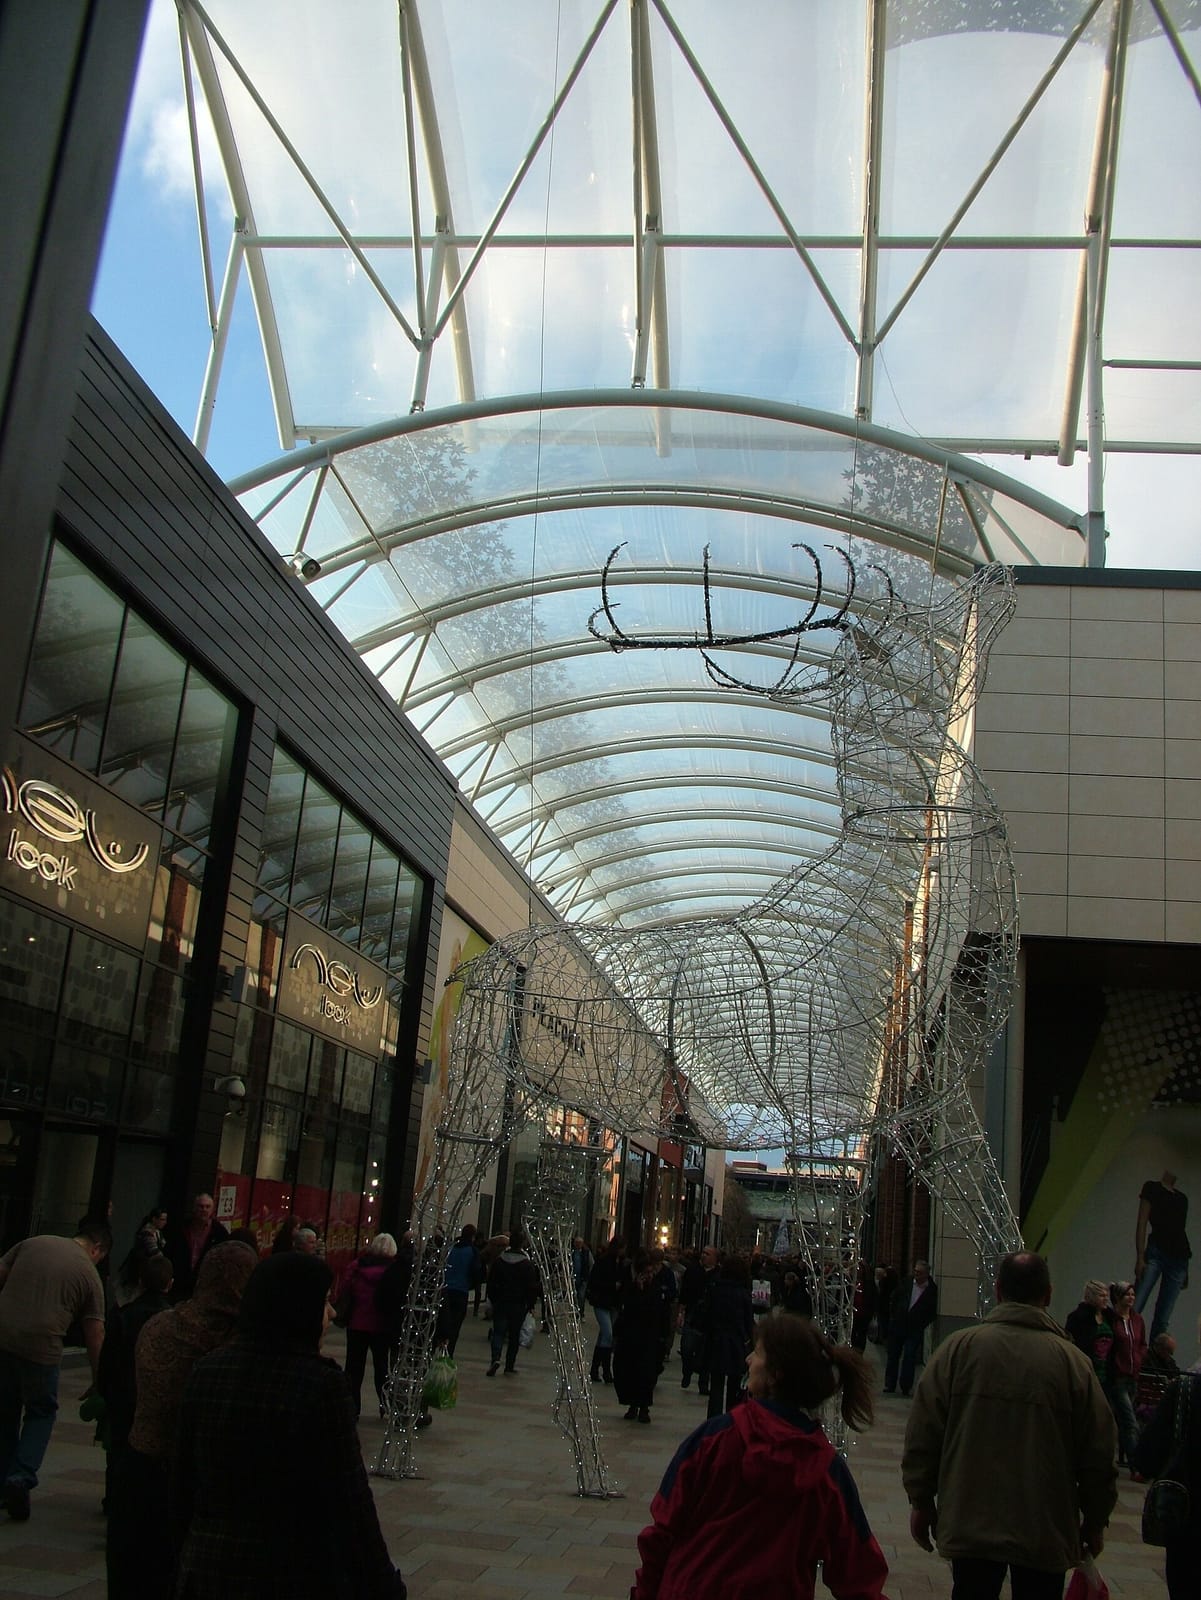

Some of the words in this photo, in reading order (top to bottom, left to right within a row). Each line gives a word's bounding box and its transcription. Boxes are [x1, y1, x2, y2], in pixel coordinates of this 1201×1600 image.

[7, 828, 78, 891] look
[290, 943, 383, 1009] new
[319, 993, 352, 1026] look
